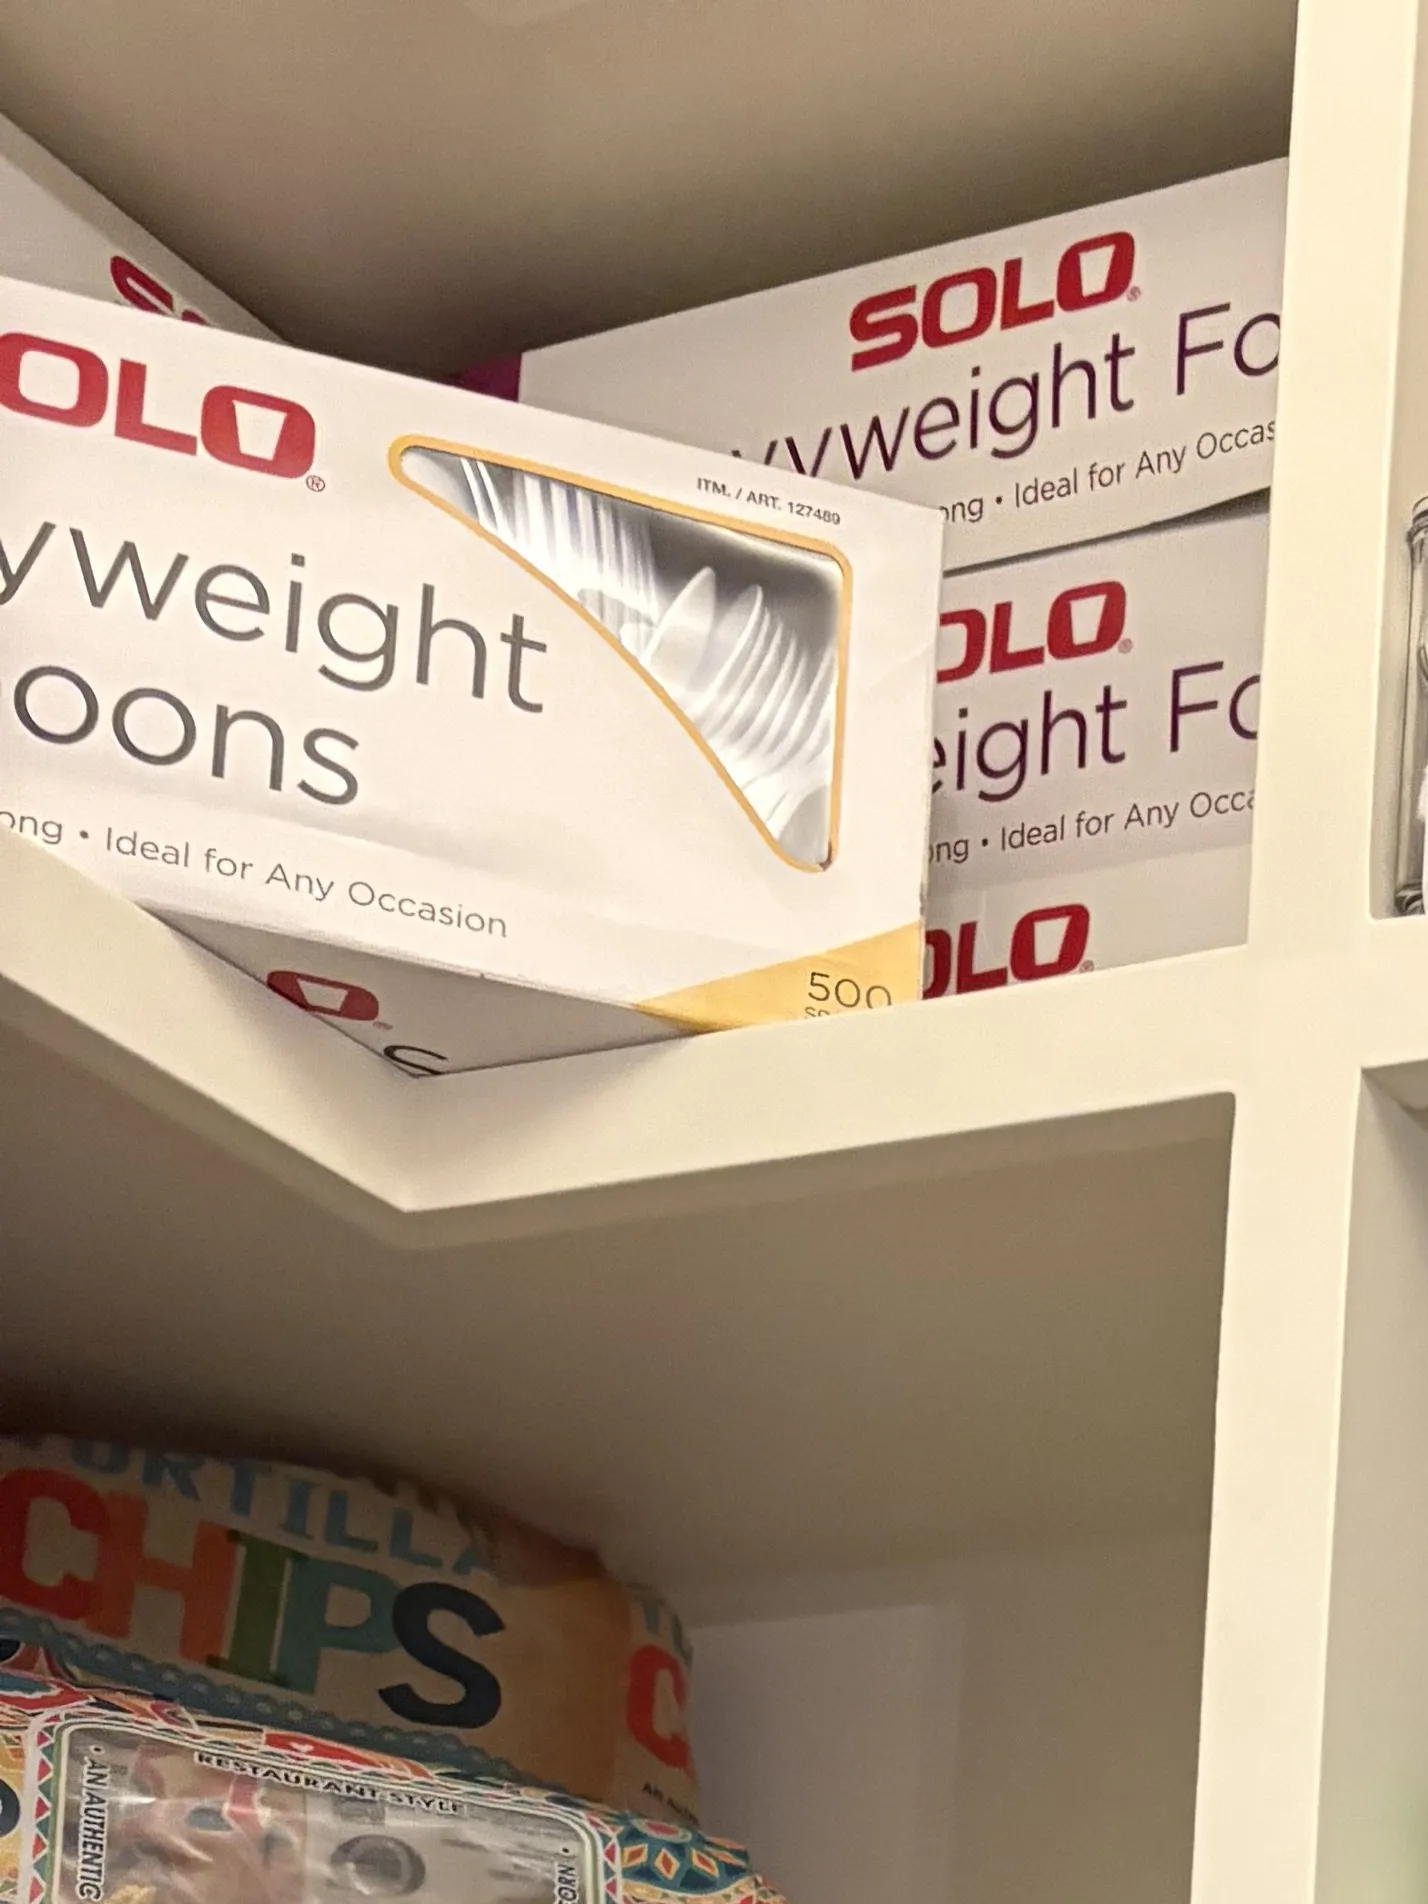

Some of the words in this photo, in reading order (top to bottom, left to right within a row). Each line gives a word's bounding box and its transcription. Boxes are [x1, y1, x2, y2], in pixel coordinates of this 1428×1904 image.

[849, 231, 1134, 371] SOLO
[0, 332, 315, 479] OLO
[746, 490, 782, 512] ART.
[1015, 469, 1079, 508] Ideal
[1088, 462, 1126, 489] for
[1135, 446, 1186, 480] Any
[1000, 816, 1065, 850] Ideal
[1076, 810, 1113, 838] for
[1124, 801, 1179, 830] Any
[106, 827, 189, 867] Ideal
[205, 849, 253, 880] for
[266, 863, 334, 902] Any
[349, 881, 507, 937] Occasion
[0, 1468, 506, 1730] CHIPS
[195, 1752, 380, 1803] RESTAURANT
[77, 1789, 108, 1902] AUTHENTIC
